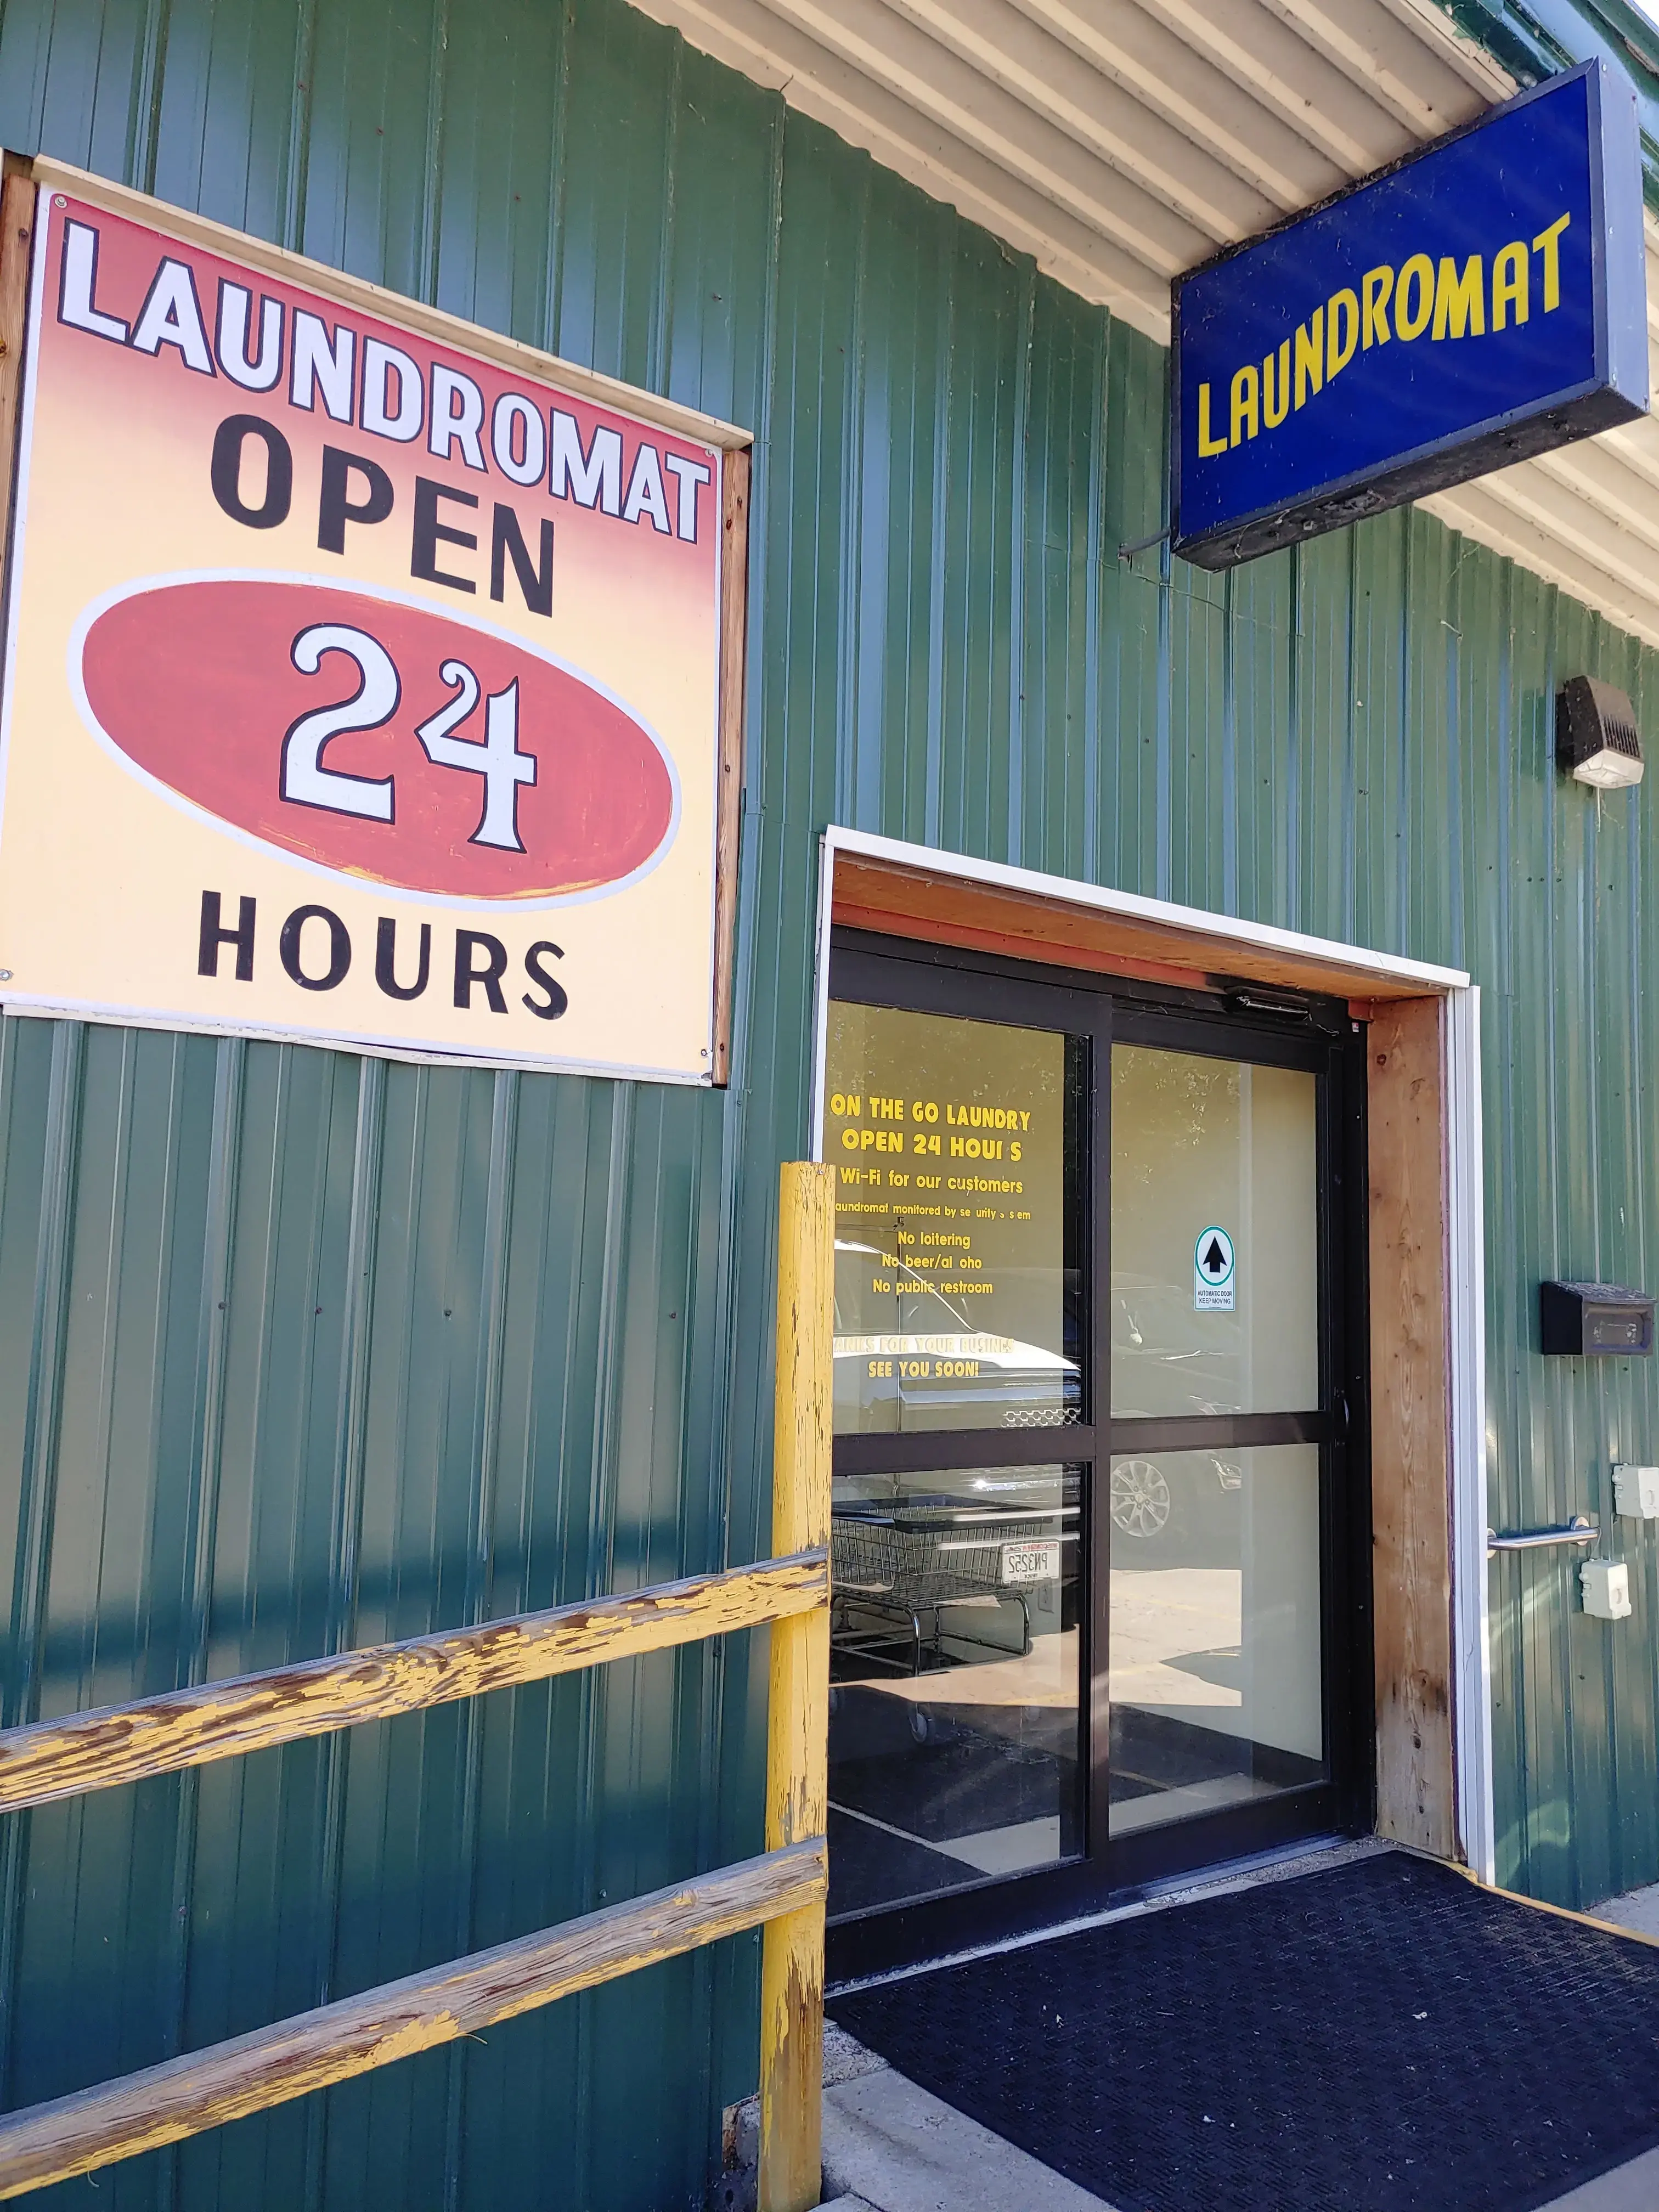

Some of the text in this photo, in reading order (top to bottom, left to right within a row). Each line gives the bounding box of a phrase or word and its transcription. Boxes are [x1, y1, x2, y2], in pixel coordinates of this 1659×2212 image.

[1198, 212, 1570, 458] LAUNDROMAT
[58, 218, 710, 544] LAUNDROMAT
[211, 414, 554, 618] OPEN
[280, 623, 537, 854] 24
[198, 890, 568, 1021] HOURS
[831, 1093, 1030, 1131] ON THE GO LAUNDRY
[842, 1129, 904, 1153] OPEN
[913, 1134, 941, 1155] 24
[840, 1167, 1023, 1194] Wi-Fi for our customers
[835, 1202, 889, 1214] aundromat
[893, 1205, 940, 1216] monitored
[945, 1206, 956, 1218] by
[960, 1207, 996, 1220] seurity
[898, 1231, 970, 1250] No loitering
[882, 1254, 899, 1267] No
[873, 1279, 993, 1295] No public restroom
[834, 1337, 875, 1353] ANKS
[880, 1337, 909, 1353] FOR
[915, 1337, 955, 1353] YOUR
[868, 1361, 979, 1378] SEE YOU SOON!
